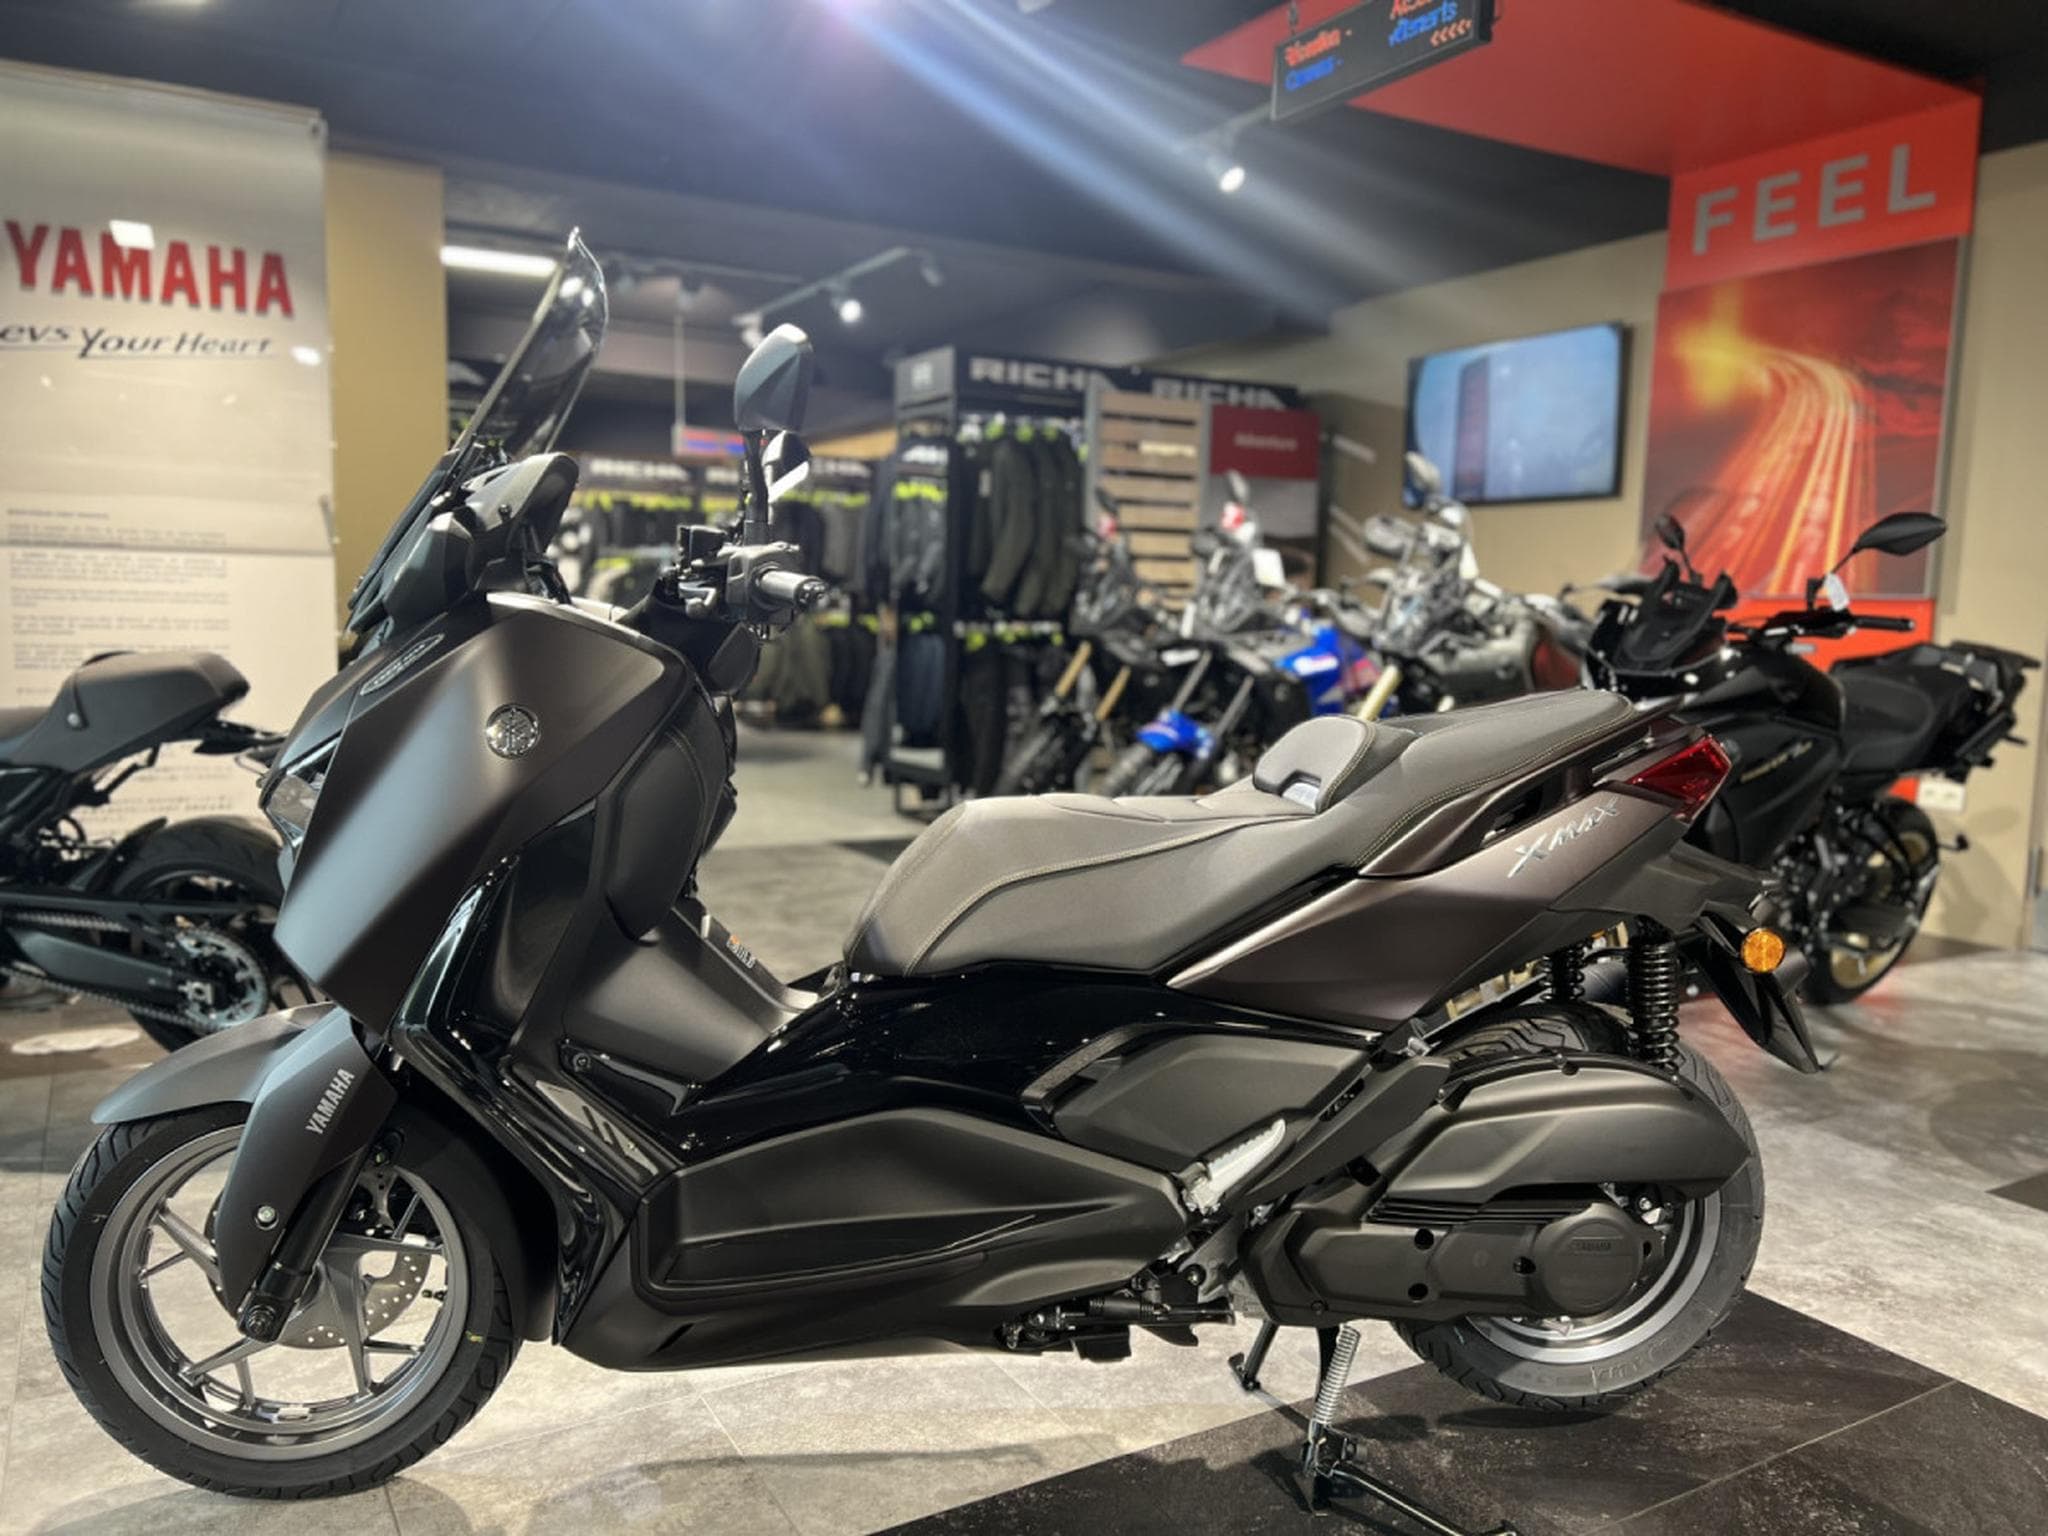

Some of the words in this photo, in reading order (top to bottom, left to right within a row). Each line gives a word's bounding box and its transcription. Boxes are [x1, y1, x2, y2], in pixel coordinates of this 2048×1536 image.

[1692, 143, 1936, 256] FEEL
[4, 218, 294, 318] YAMAHA
[78, 327, 168, 360] Your
[172, 332, 273, 355] Heart
[305, 1068, 355, 1134] YAMAHA
